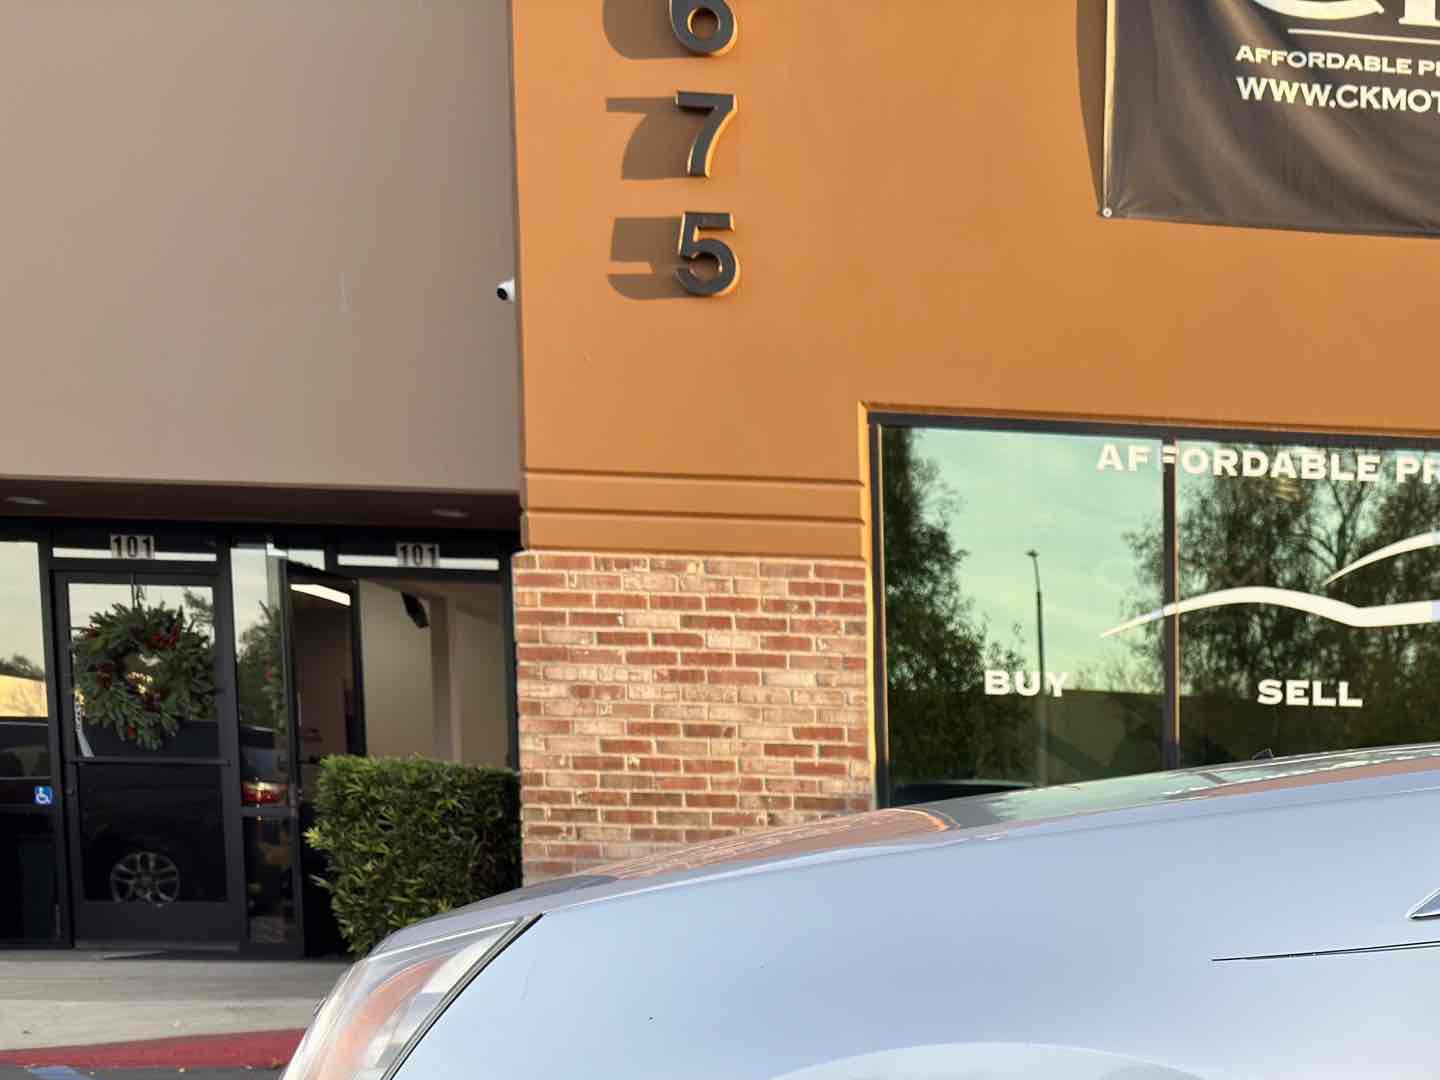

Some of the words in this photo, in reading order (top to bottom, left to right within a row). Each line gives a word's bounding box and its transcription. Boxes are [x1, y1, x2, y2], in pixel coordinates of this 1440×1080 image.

[1235, 45, 1412, 75] AFFORDABLE
[1096, 443, 1381, 482] AFFORDABLE
[112, 535, 153, 558] 101
[399, 543, 437, 567] 101
[984, 670, 1068, 697] BUY
[1257, 679, 1363, 707] SELL
